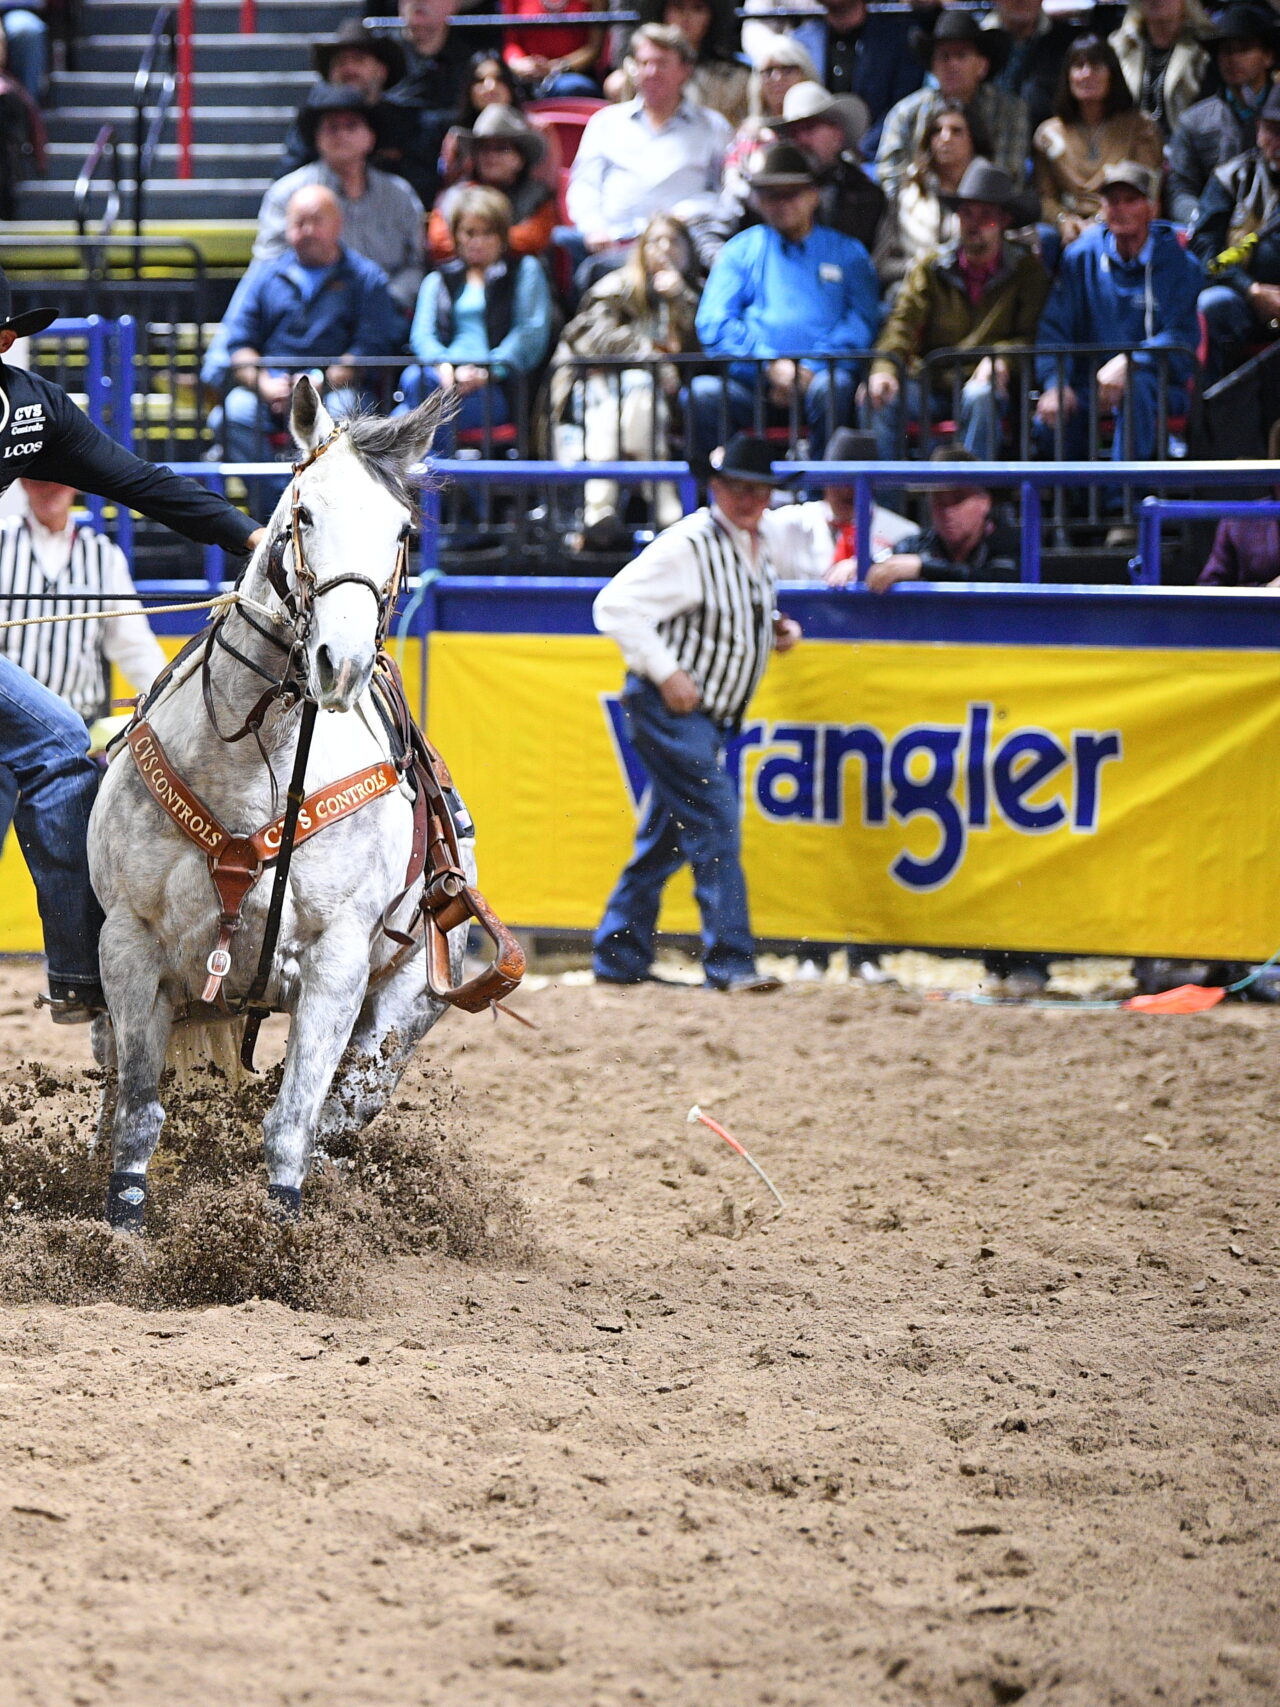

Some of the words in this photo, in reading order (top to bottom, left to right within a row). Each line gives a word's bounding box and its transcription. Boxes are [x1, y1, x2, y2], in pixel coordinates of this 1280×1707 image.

[11, 422, 44, 436] Controls
[14, 403, 43, 421] CVS
[3, 441, 43, 459] LCOS
[134, 736, 154, 772] CVS
[151, 769, 223, 848] CONTROLS
[264, 808, 312, 849] CS
[314, 770, 388, 820] CONTROLS
[600, 692, 1122, 893] rangler
